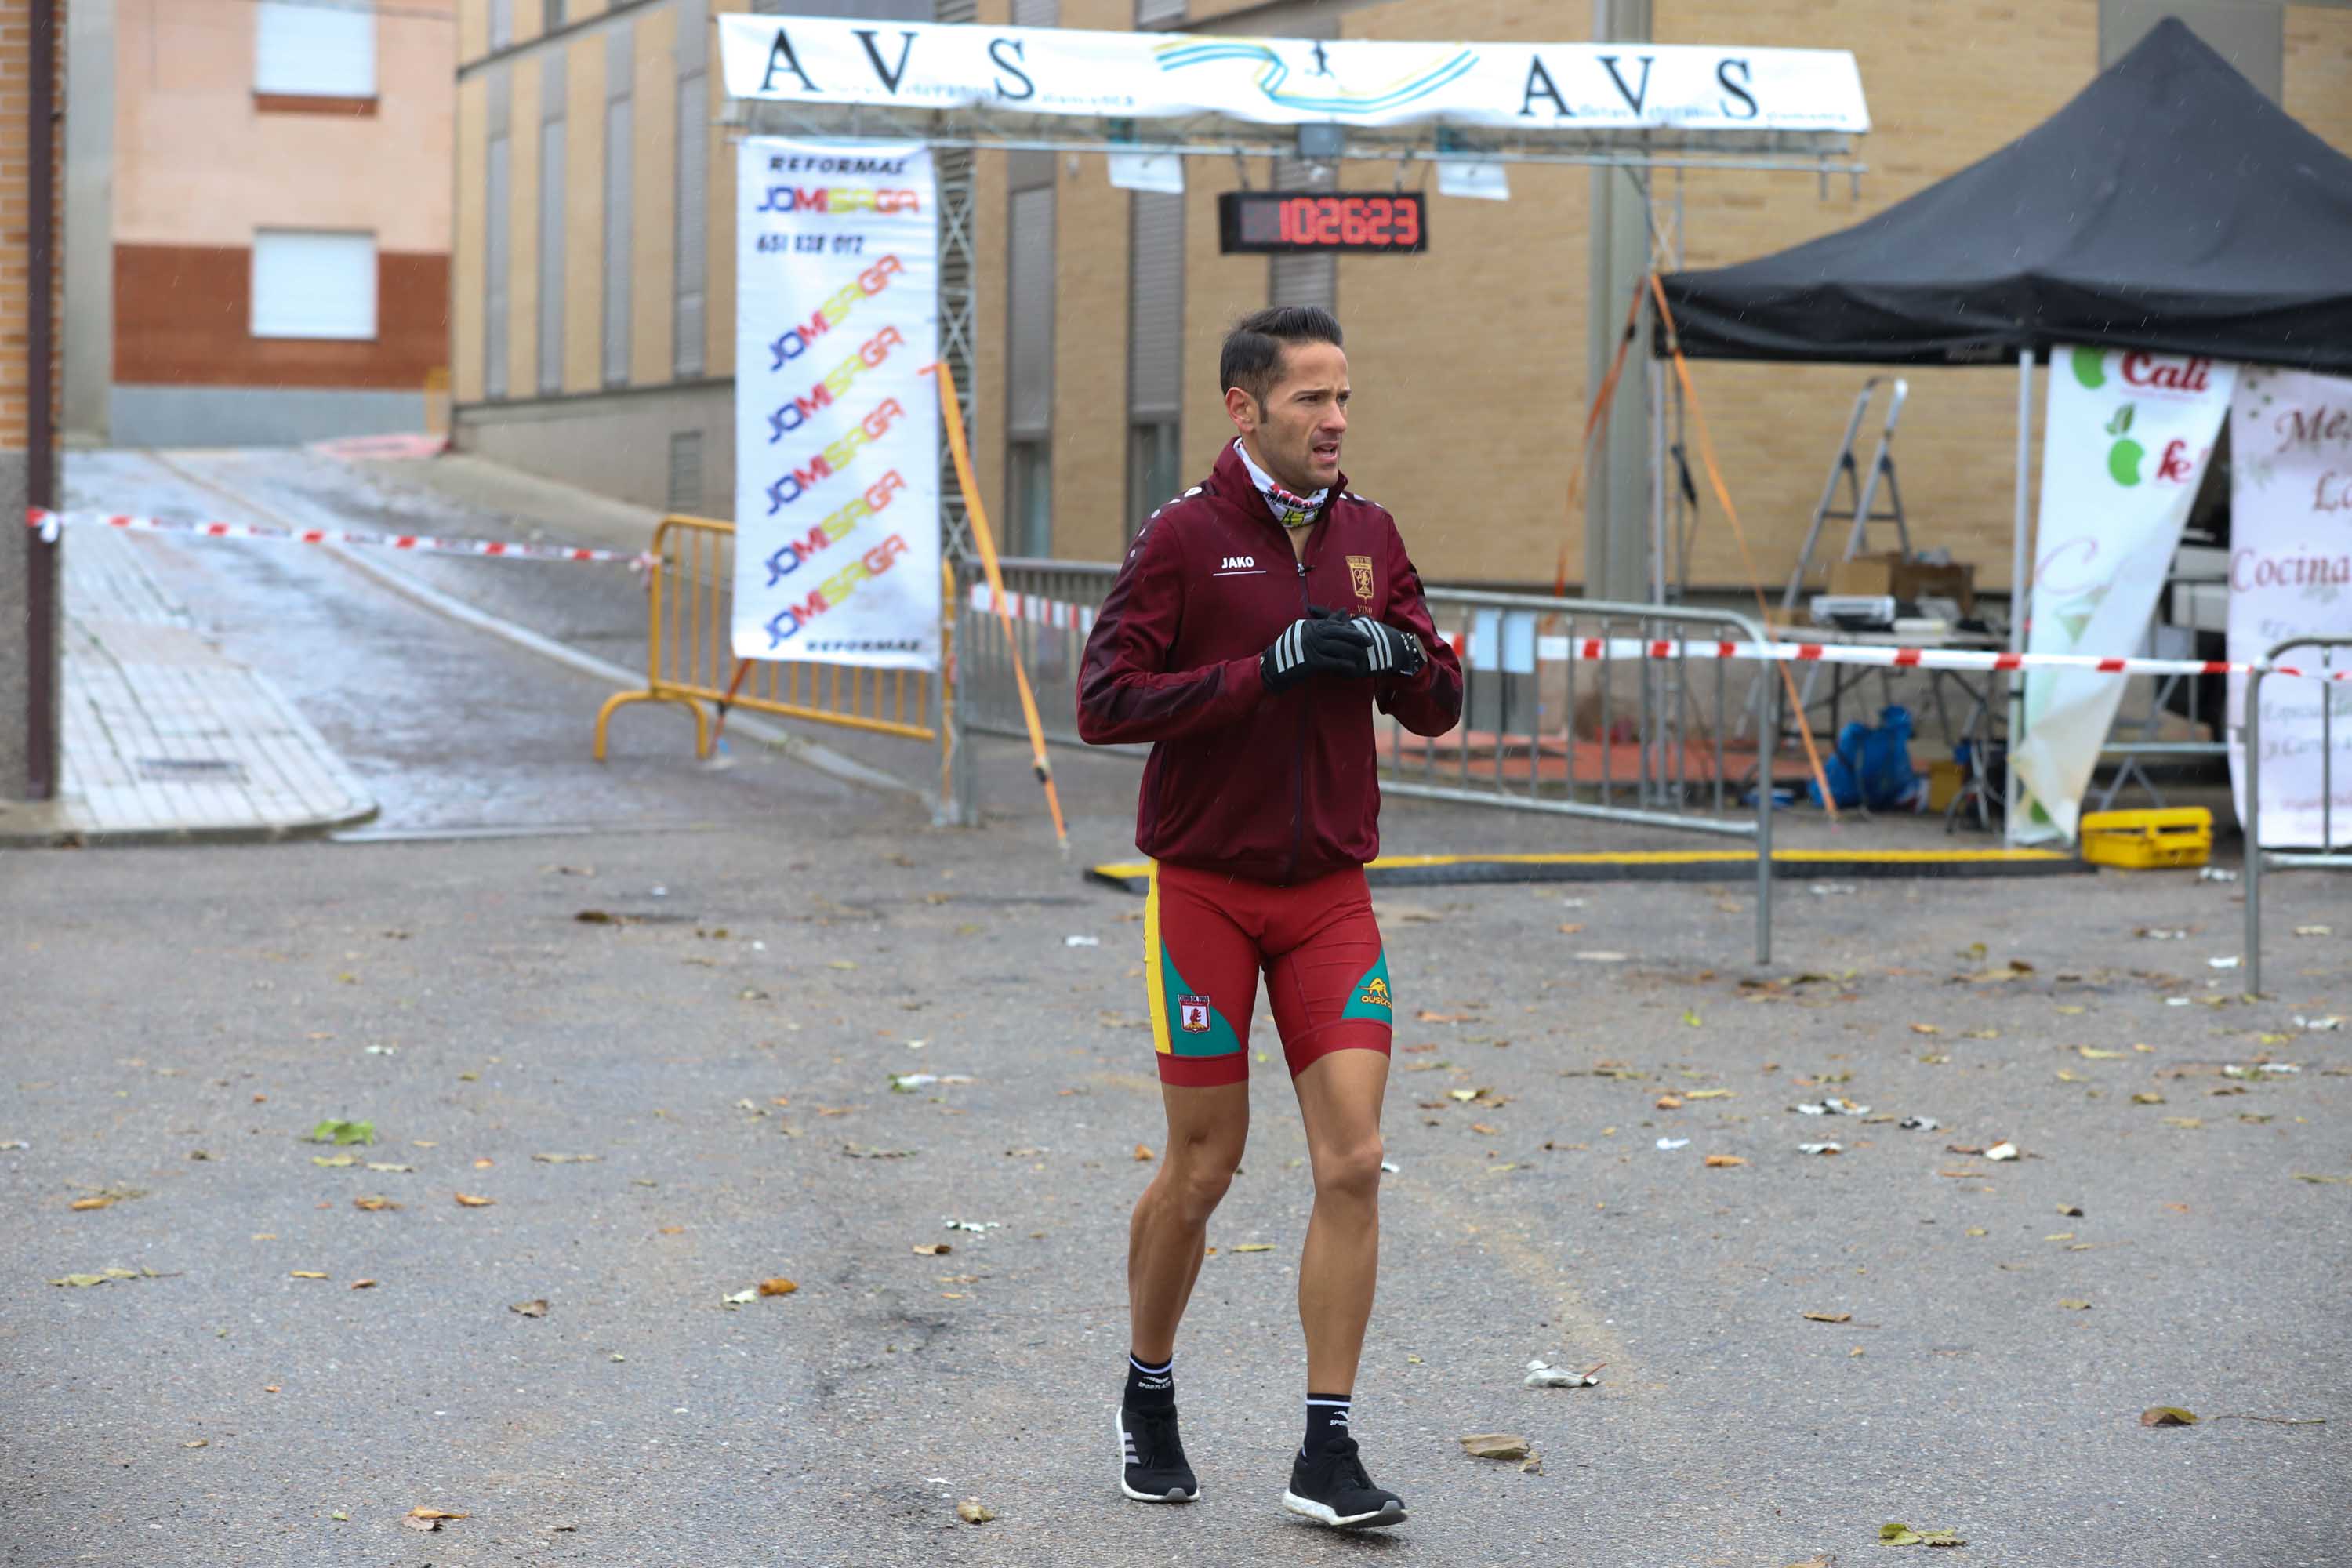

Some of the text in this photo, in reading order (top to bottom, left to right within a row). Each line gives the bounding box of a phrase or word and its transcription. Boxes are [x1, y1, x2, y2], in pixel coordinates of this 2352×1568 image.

[1221, 556, 1254, 569] JAKO
[2231, 546, 2350, 592] Cocina
[1357, 604, 1373, 615] VINO
